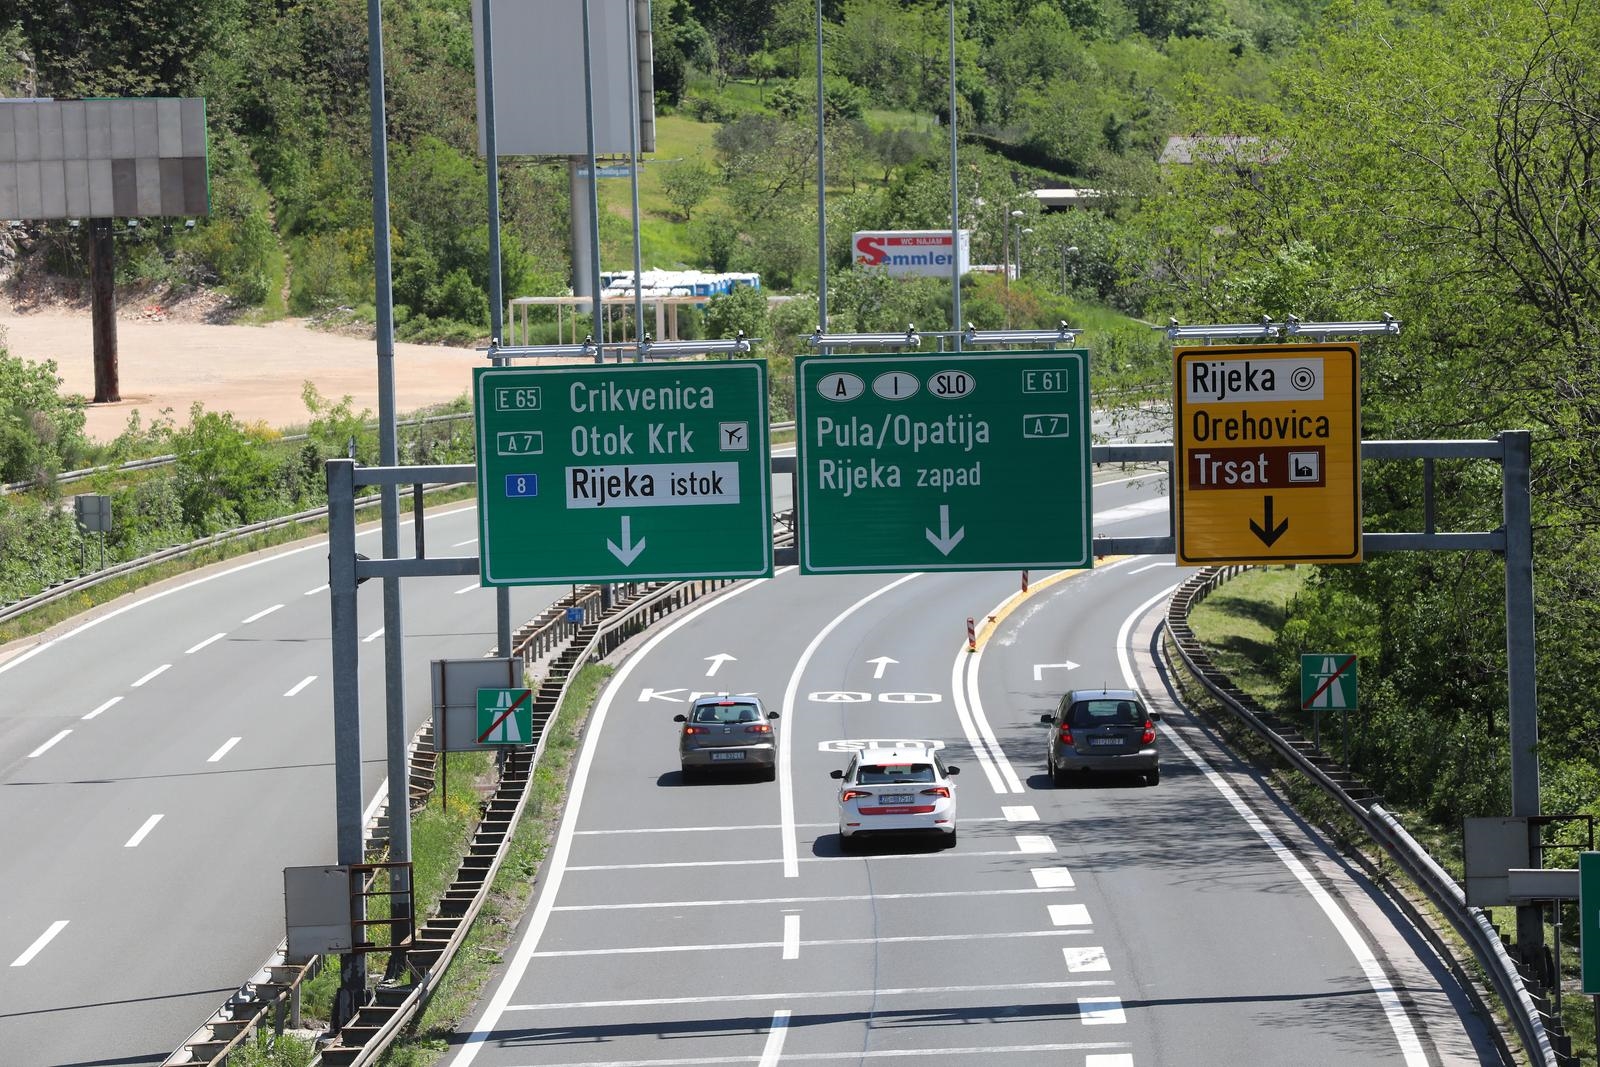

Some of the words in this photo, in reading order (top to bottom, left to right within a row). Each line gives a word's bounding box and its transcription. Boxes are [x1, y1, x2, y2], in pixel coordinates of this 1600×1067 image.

[856, 237, 953, 266] Semmler
[835, 377, 847, 397] A
[893, 376, 898, 395] I
[937, 375, 966, 394] SLO
[1027, 373, 1036, 390] E
[1043, 372, 1061, 390] 61
[1192, 361, 1275, 400] Rijeka
[500, 391, 509, 408] E
[516, 389, 537, 407] 65
[570, 381, 714, 413] Crikvenica
[571, 425, 634, 457] Otok
[649, 423, 694, 454] Krk
[817, 413, 989, 452] Pula/Opatija
[1034, 419, 1043, 434] A
[1050, 419, 1058, 433] 7
[1193, 409, 1330, 442] Orehovica
[508, 435, 518, 451] A
[524, 435, 532, 450] 7
[819, 458, 901, 497] Rijeka
[917, 461, 981, 492] zapad
[1194, 453, 1268, 485] Trsat
[517, 477, 526, 493] 8
[572, 467, 654, 506] Rijeka
[671, 470, 723, 496] istok
